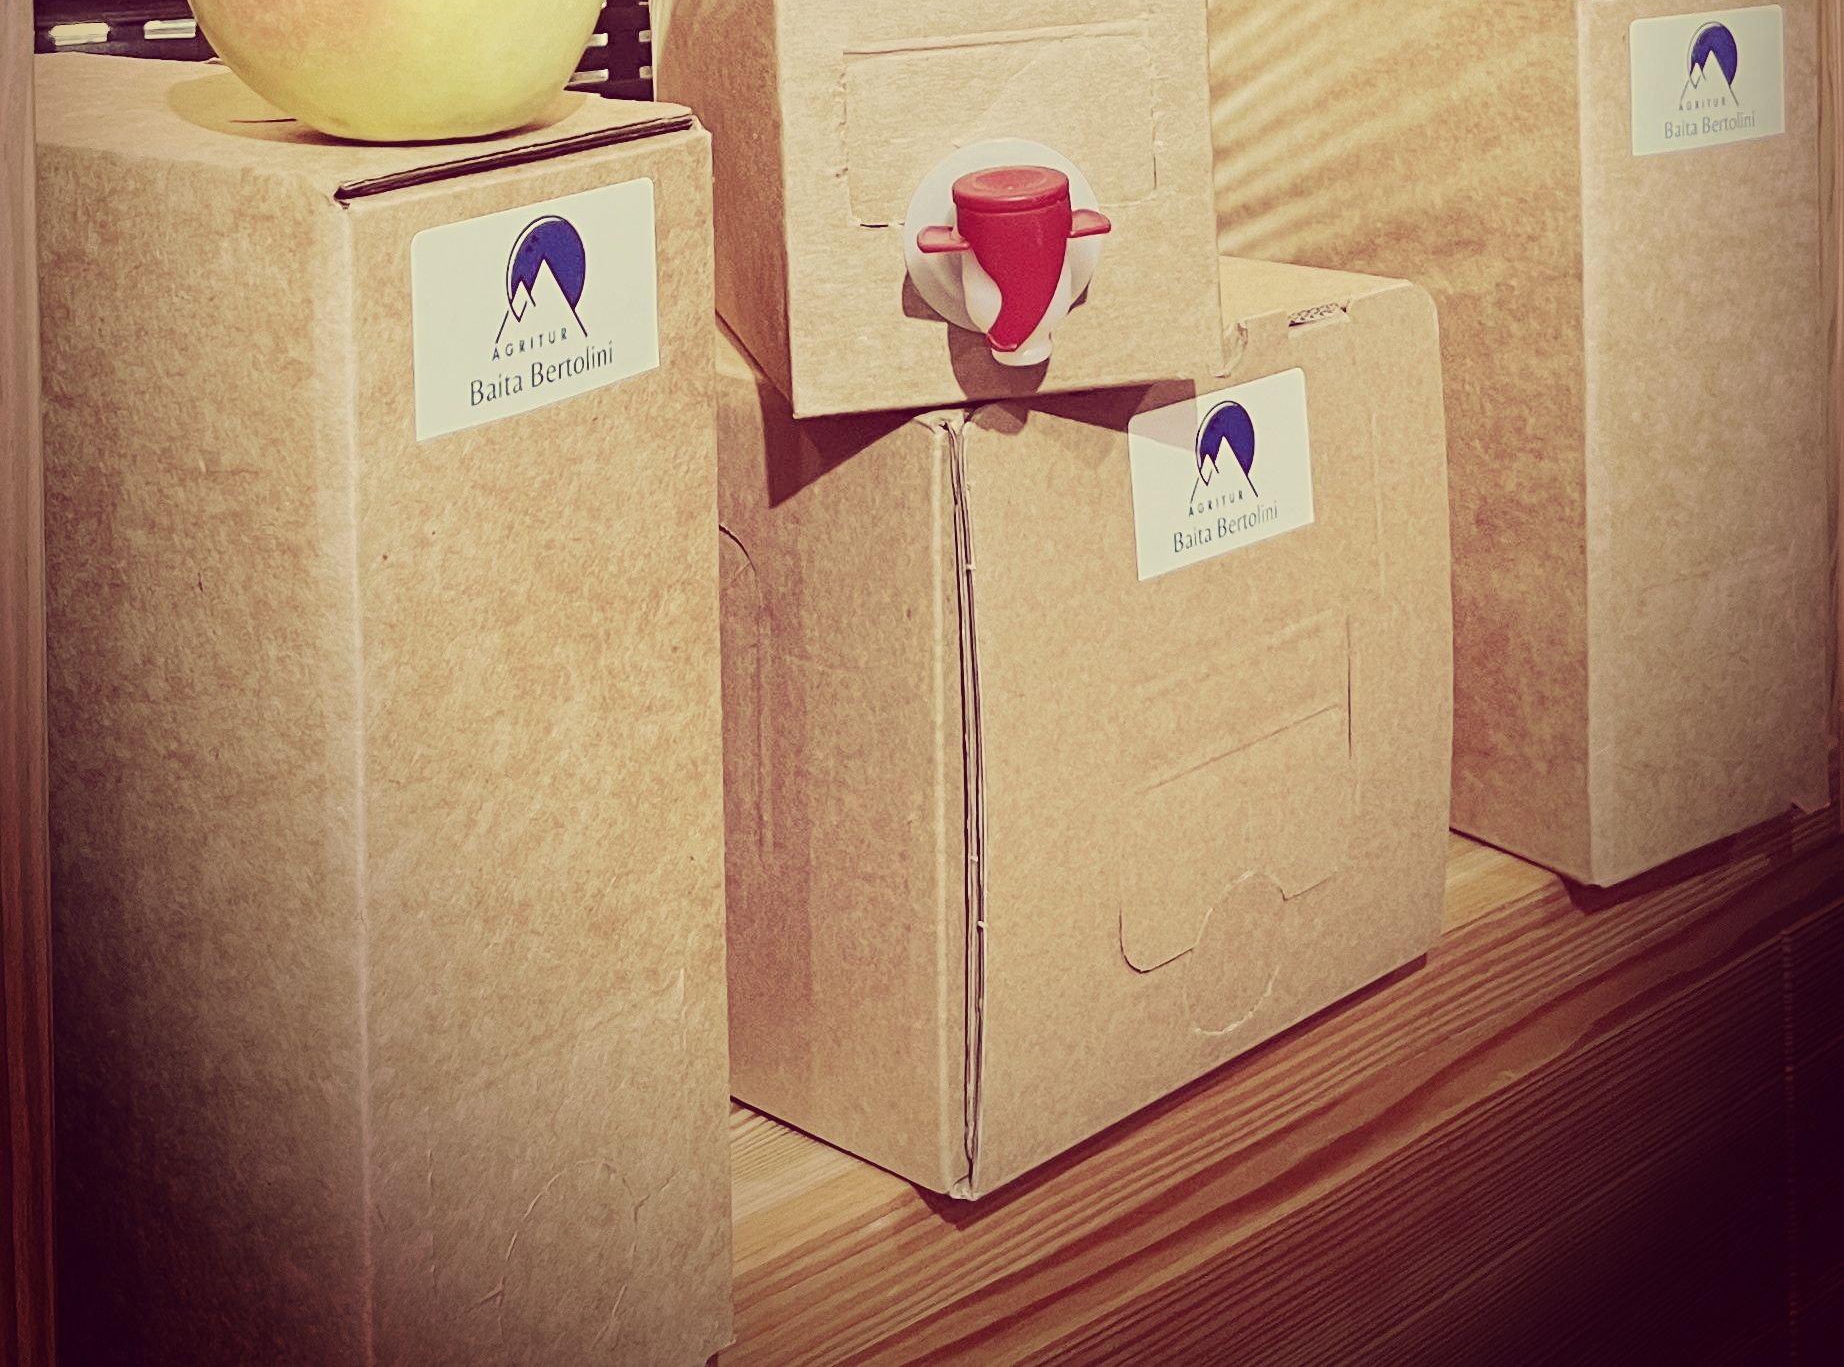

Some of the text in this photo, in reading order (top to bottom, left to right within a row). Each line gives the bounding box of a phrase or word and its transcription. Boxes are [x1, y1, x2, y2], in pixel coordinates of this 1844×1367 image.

[1664, 111, 1755, 139] Baita Bertolini
[492, 327, 567, 362] AGRITUR
[470, 339, 613, 407] Baita Bertolini
[1188, 490, 1244, 517] AGRITUR
[1173, 500, 1278, 553] Baita Bertolini
